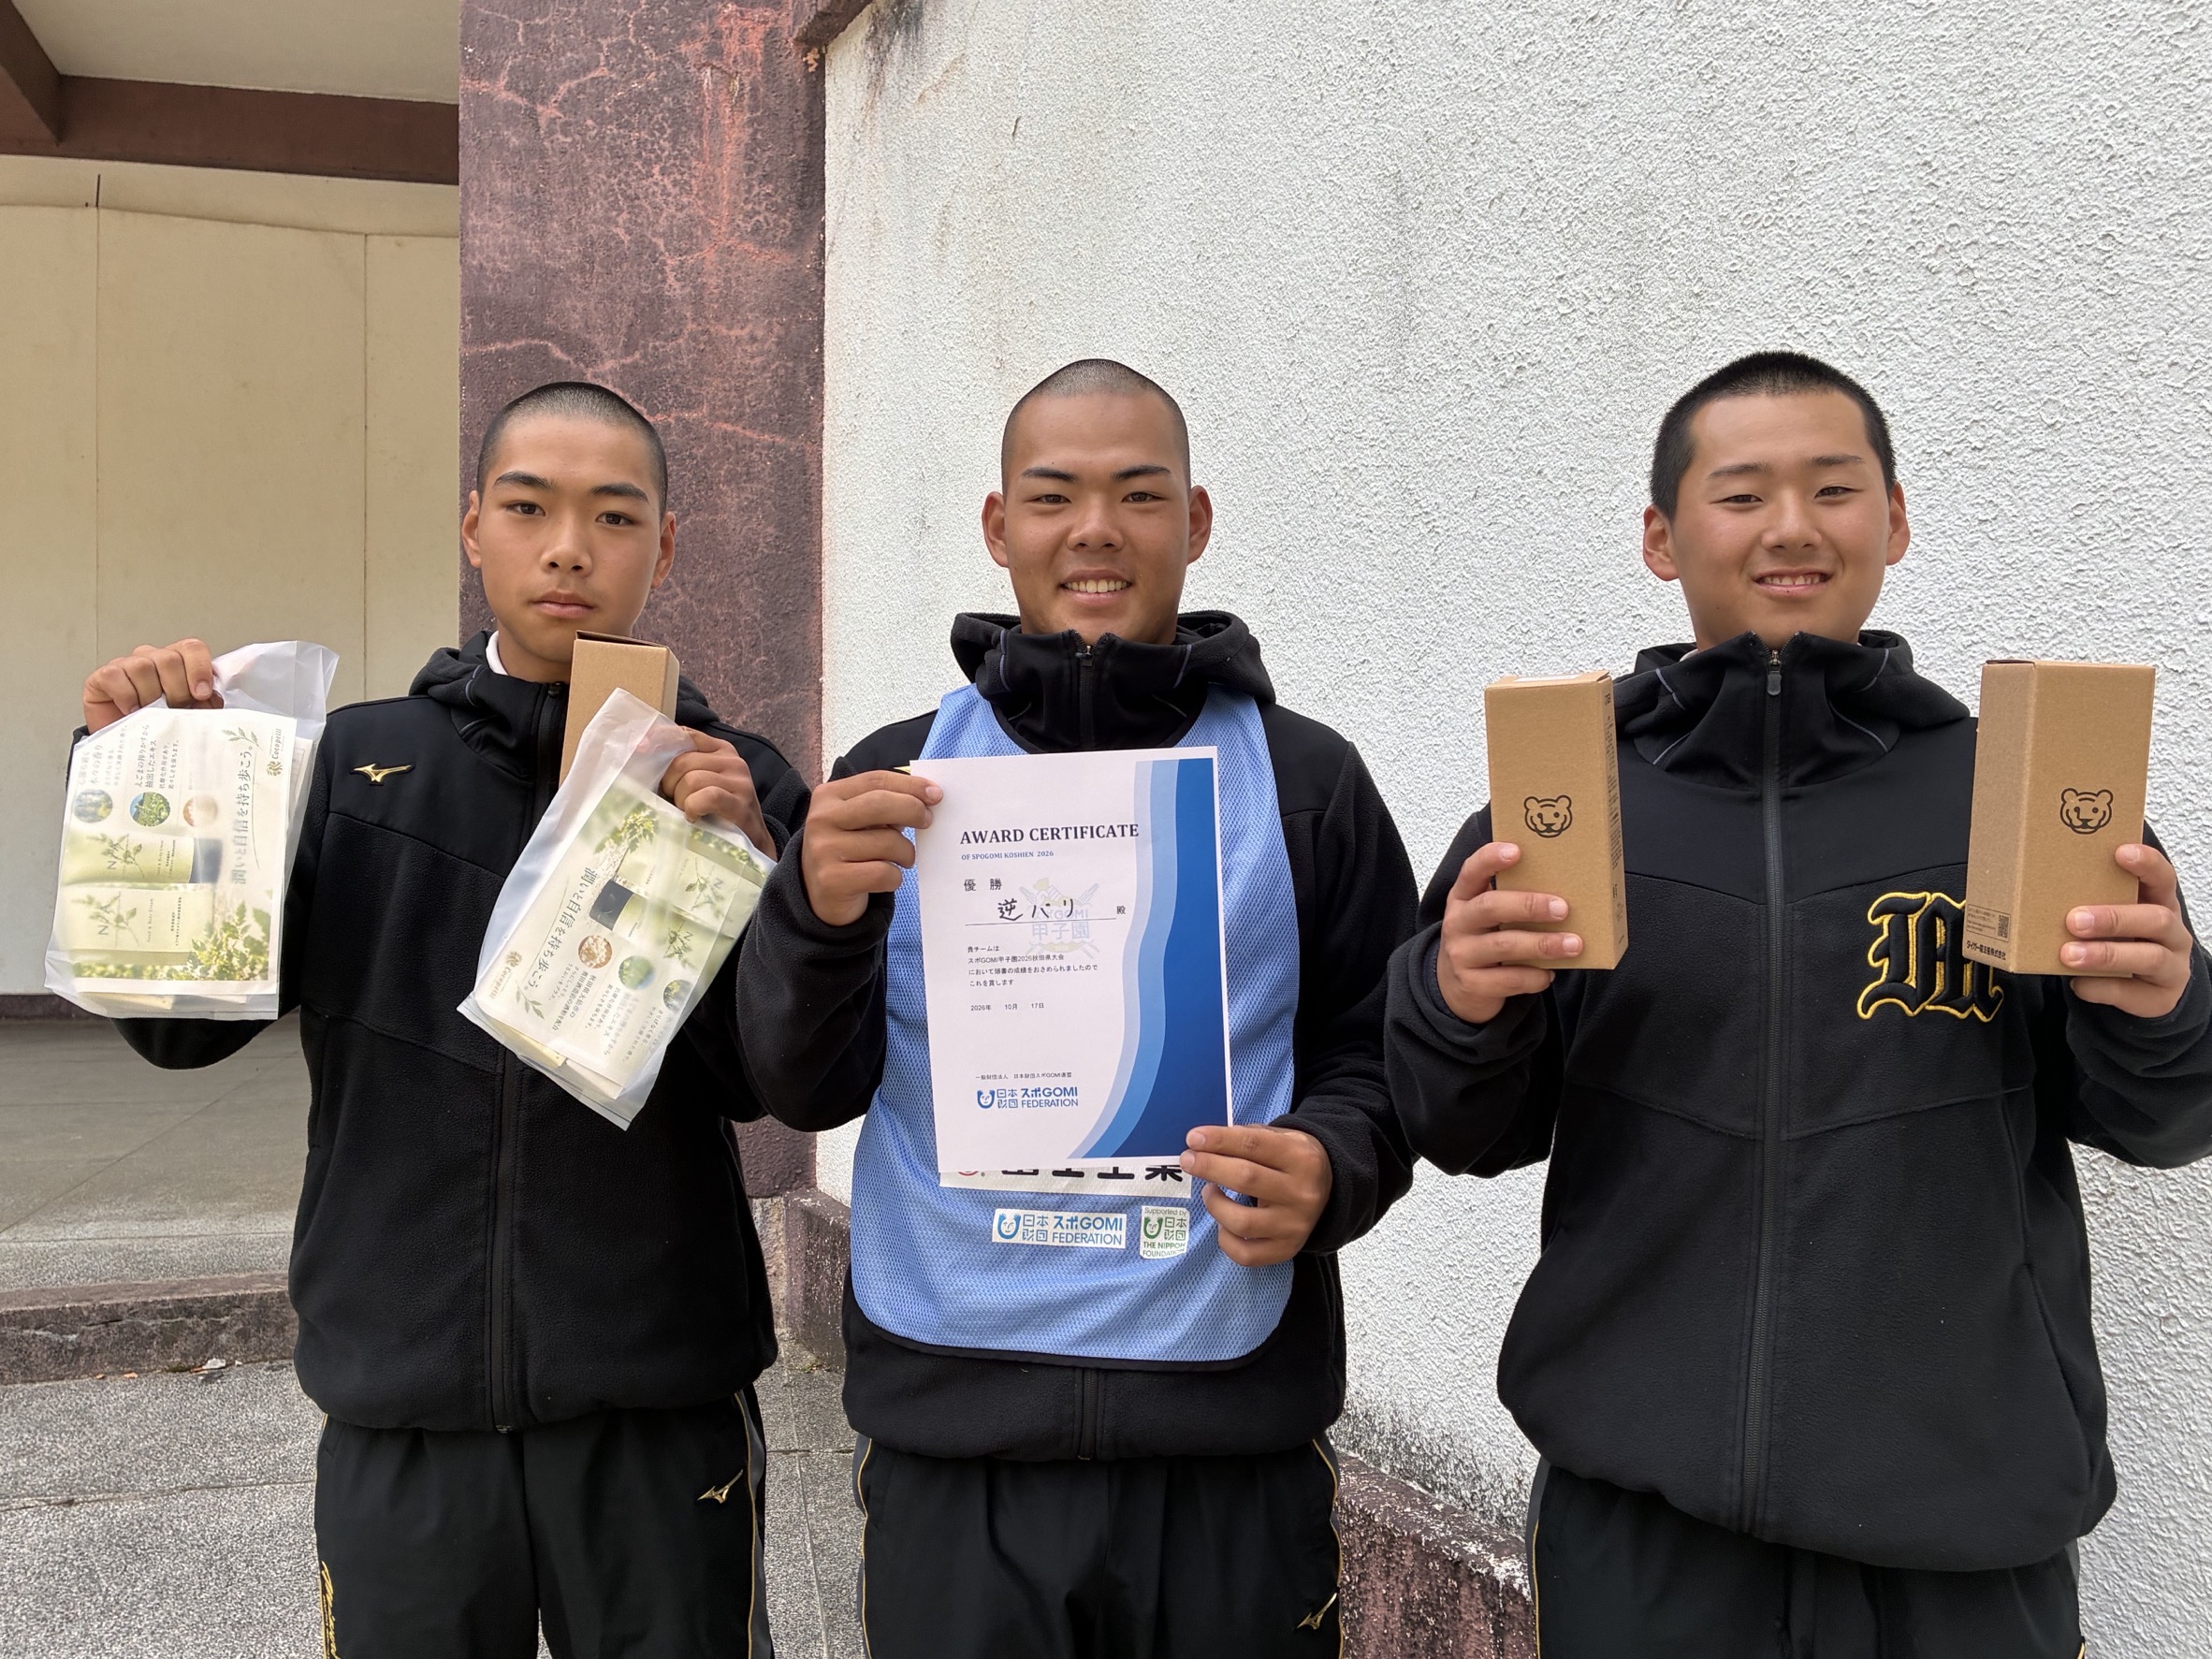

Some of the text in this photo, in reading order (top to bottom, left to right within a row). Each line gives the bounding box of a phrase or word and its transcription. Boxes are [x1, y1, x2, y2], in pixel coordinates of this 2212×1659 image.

[145, 740, 156, 788] 抽出したエキス
[231, 745, 254, 884] 潤いと自信を持ち歩こう。
[960, 824, 1139, 844] AWARD CERTIFICATE
[997, 898, 1074, 921] 逆バリ
[1117, 906, 1126, 914] 殿
[522, 866, 599, 996] 潤いと自信を持ち歩こう。
[1033, 922, 1089, 940] 甲子園
[969, 979, 1014, 987] これを賞します
[568, 973, 597, 1019] 秋田県大仙市の
[997, 1086, 1078, 1099] 日本 スポGOMI
[1021, 1099, 1078, 1108] FEDERATION
[1144, 1207, 1177, 1215] Supported
[1023, 1215, 1123, 1231] 日本 スポGOMI
[1165, 1217, 1186, 1228] 日本
[1052, 1231, 1122, 1245] FEDERATION
